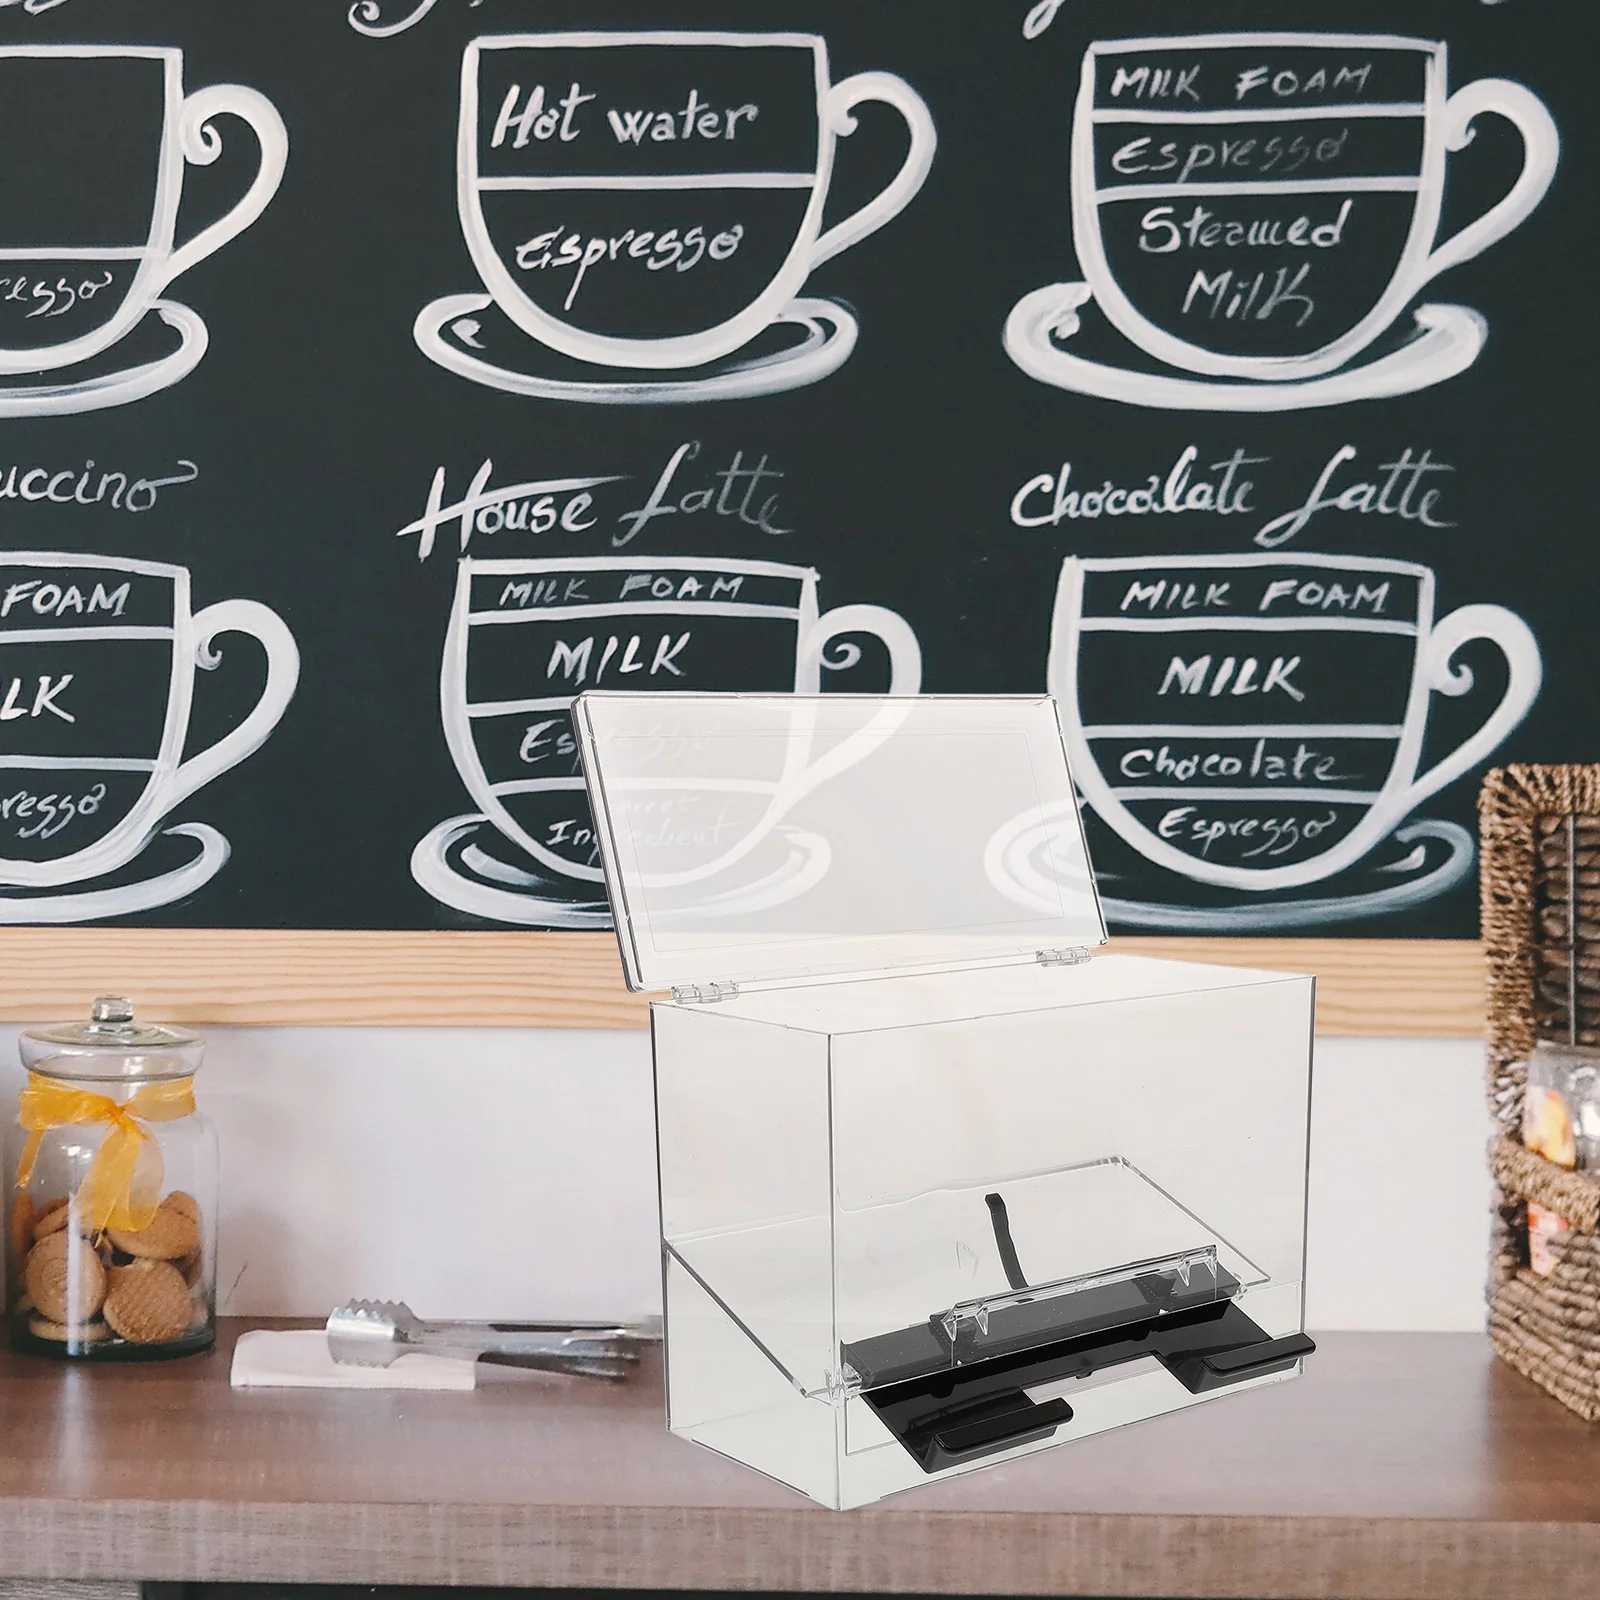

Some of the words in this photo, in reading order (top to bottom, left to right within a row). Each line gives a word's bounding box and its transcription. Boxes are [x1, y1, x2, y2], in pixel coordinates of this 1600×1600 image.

[1110, 65, 1201, 101] MILK
[1235, 64, 1372, 101] FOAM
[490, 82, 597, 149] Hot
[607, 89, 759, 146] water
[1112, 129, 1349, 184] Espresso
[1138, 198, 1354, 253] Steamed
[514, 224, 744, 312] Espresso
[395, 458, 634, 562] House
[612, 440, 795, 547] Latte
[1009, 445, 1270, 527] Chocolate
[1254, 444, 1457, 548] Latte
[0, 580, 131, 617] FOAM
[499, 578, 590, 607] MILK
[619, 573, 744, 601] FOAM
[1120, 580, 1231, 612] MILK
[1259, 579, 1391, 613] FOAM
[547, 632, 690, 685] MILK
[1157, 655, 1306, 701] MILK
[1119, 740, 1358, 783] Chocolate
[0, 783, 107, 840] resso
[1156, 806, 1338, 858] Espresso
